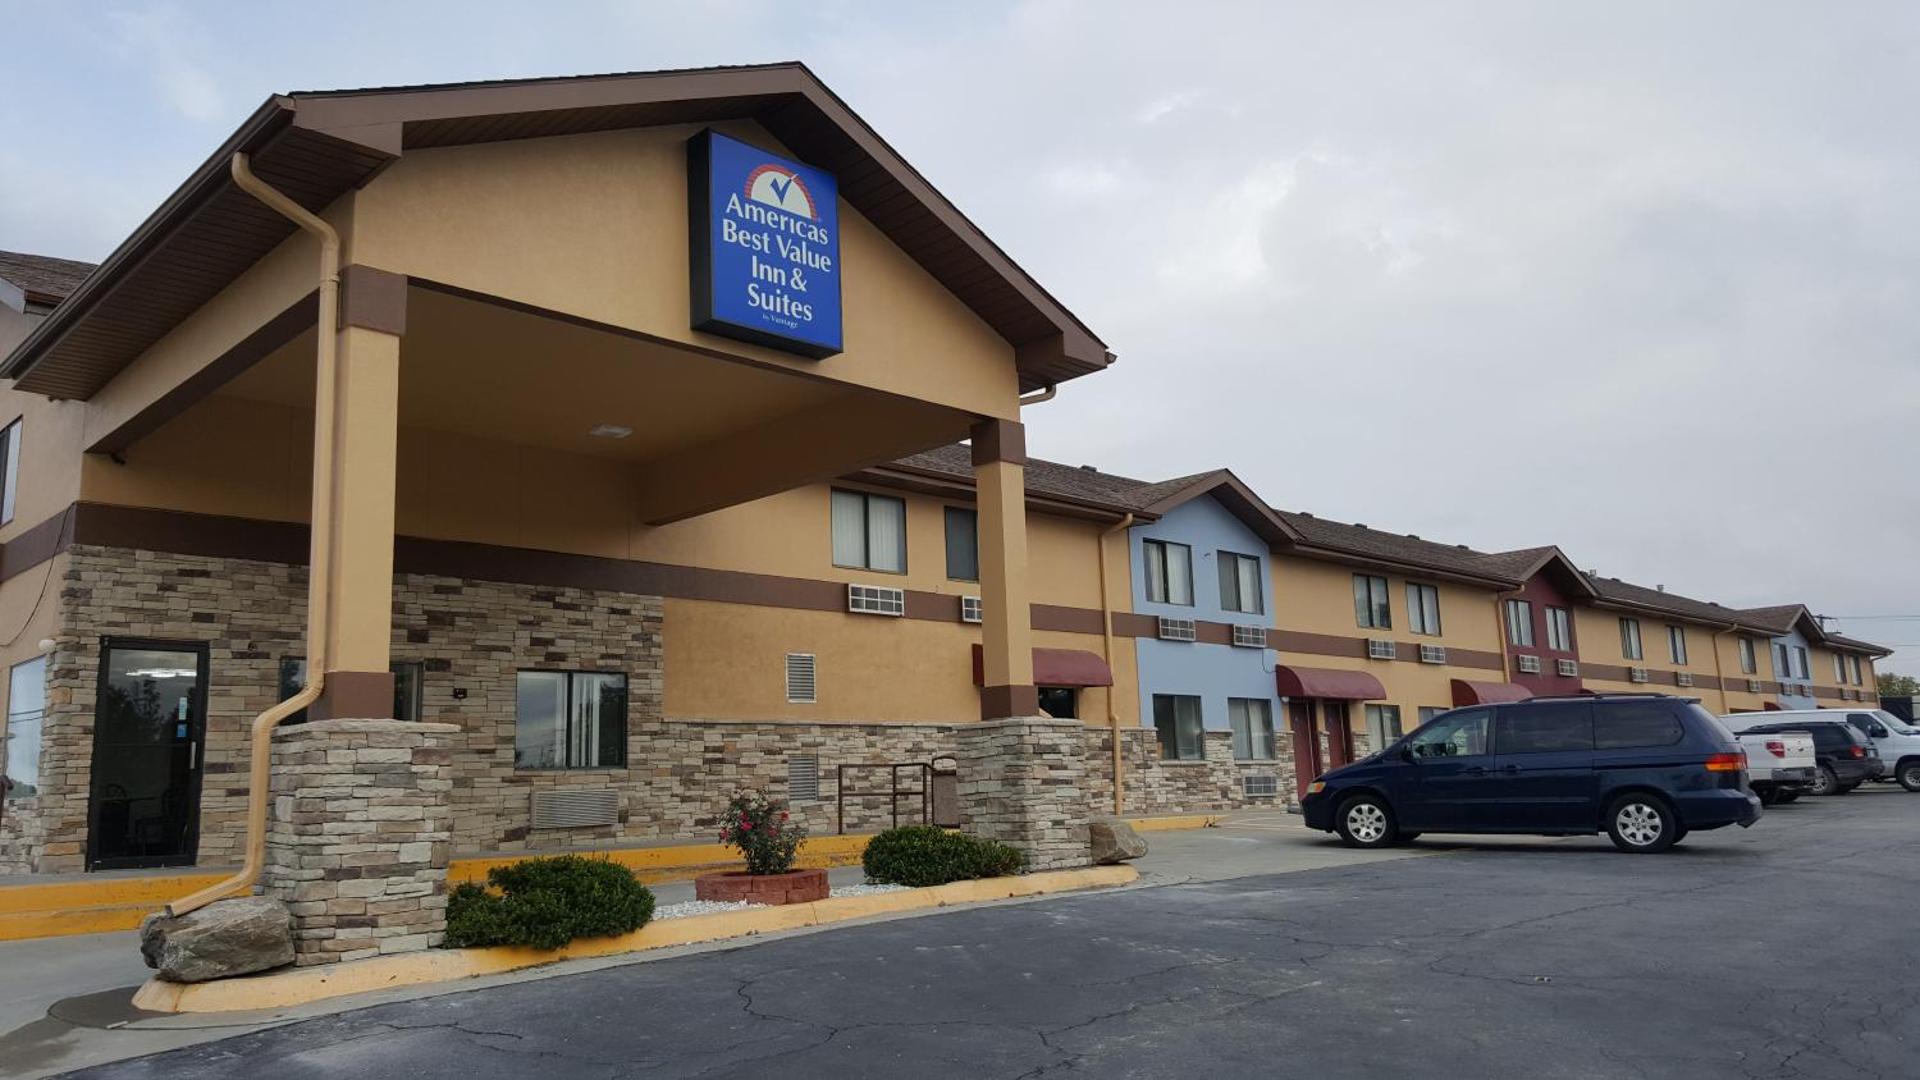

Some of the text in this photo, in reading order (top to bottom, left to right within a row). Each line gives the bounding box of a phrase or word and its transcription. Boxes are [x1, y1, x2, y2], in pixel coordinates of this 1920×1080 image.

[726, 193, 828, 245] Americas
[723, 219, 832, 272] Best Value
[752, 256, 807, 292] Inn &
[748, 284, 812, 321] Suites
